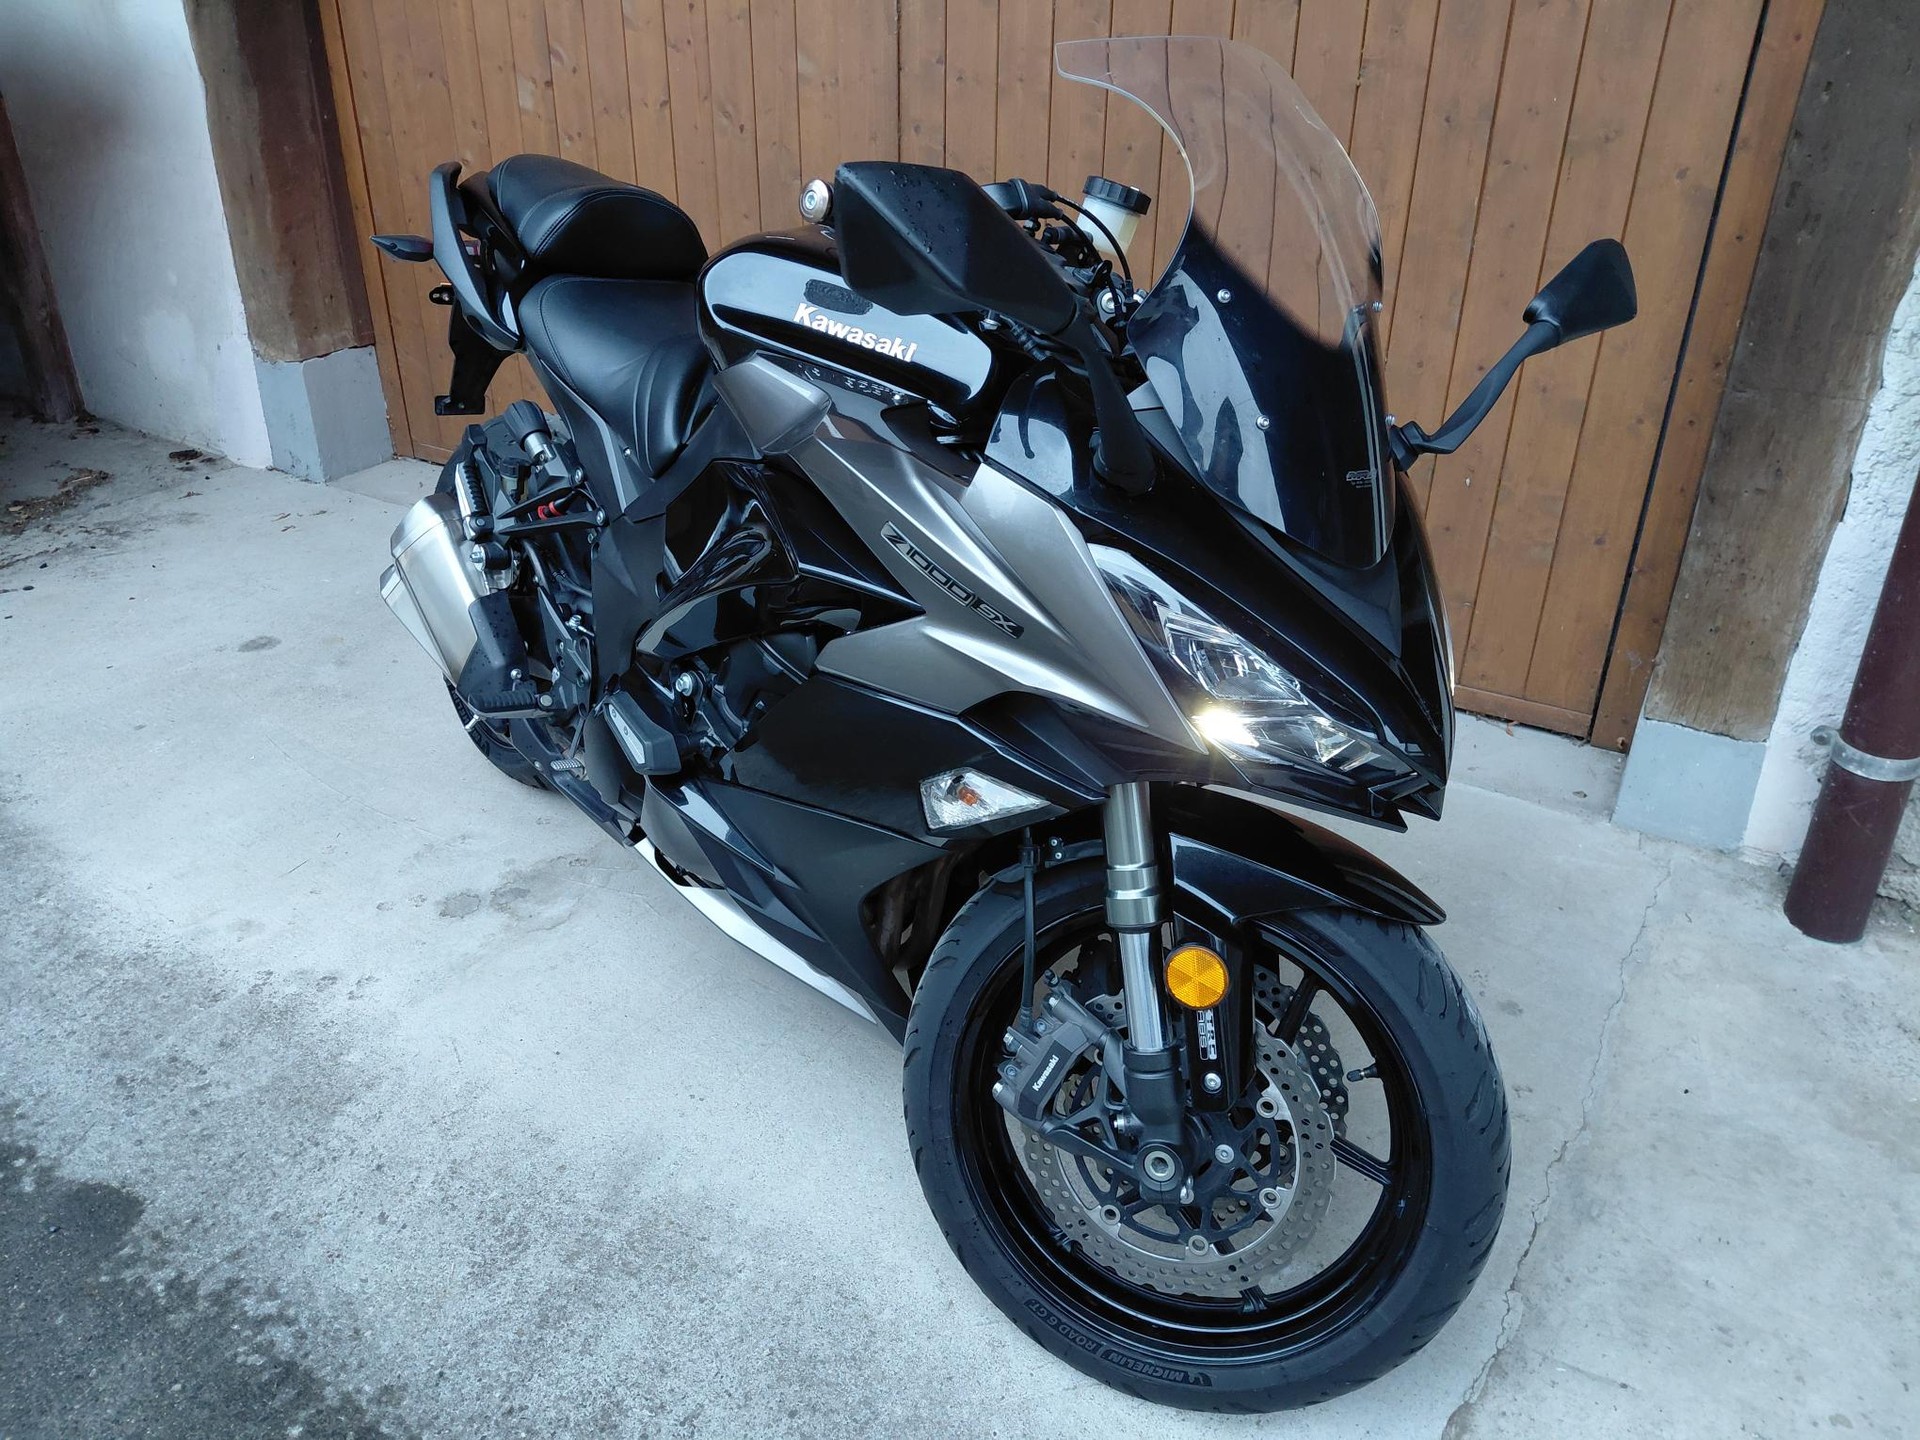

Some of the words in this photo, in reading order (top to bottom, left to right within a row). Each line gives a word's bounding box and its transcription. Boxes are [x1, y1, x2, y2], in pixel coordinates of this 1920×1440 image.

[793, 302, 918, 363] Kawasaki
[1032, 1055, 1060, 1092] Kawasaki
[1058, 1324, 1097, 1352] ROAD
[1108, 1353, 1184, 1380] MICHELIN
